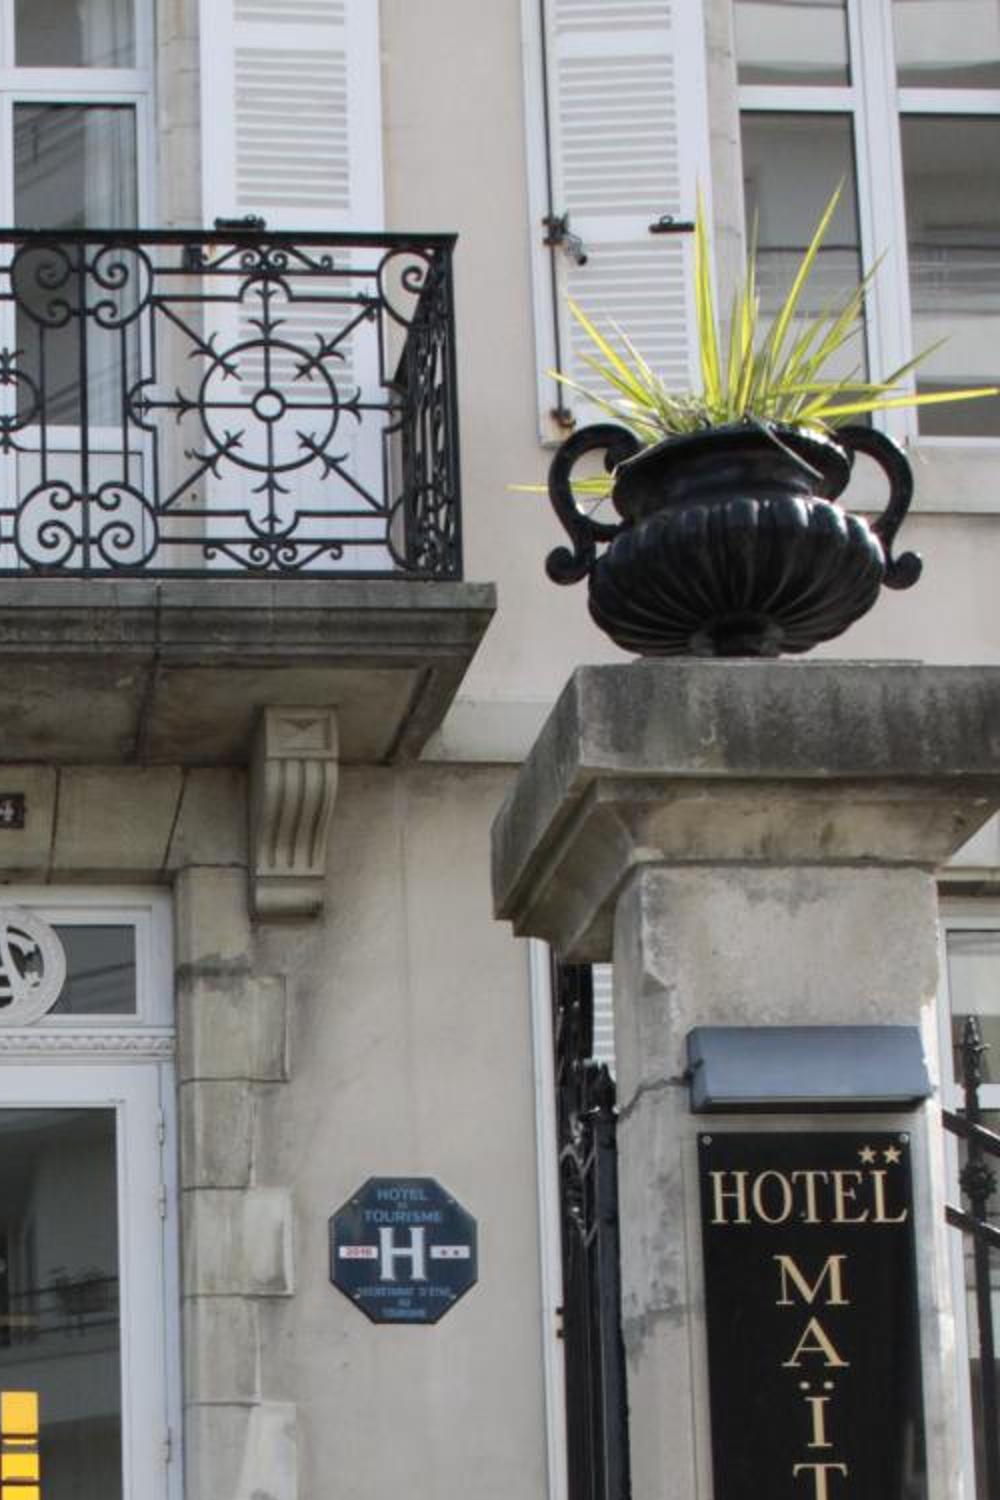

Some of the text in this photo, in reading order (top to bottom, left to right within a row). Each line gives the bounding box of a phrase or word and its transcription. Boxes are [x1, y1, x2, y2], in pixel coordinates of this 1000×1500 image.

[365, 1209, 442, 1223] TOURISME
[708, 1170, 908, 1224] HOTEL
[378, 1226, 426, 1281] H
